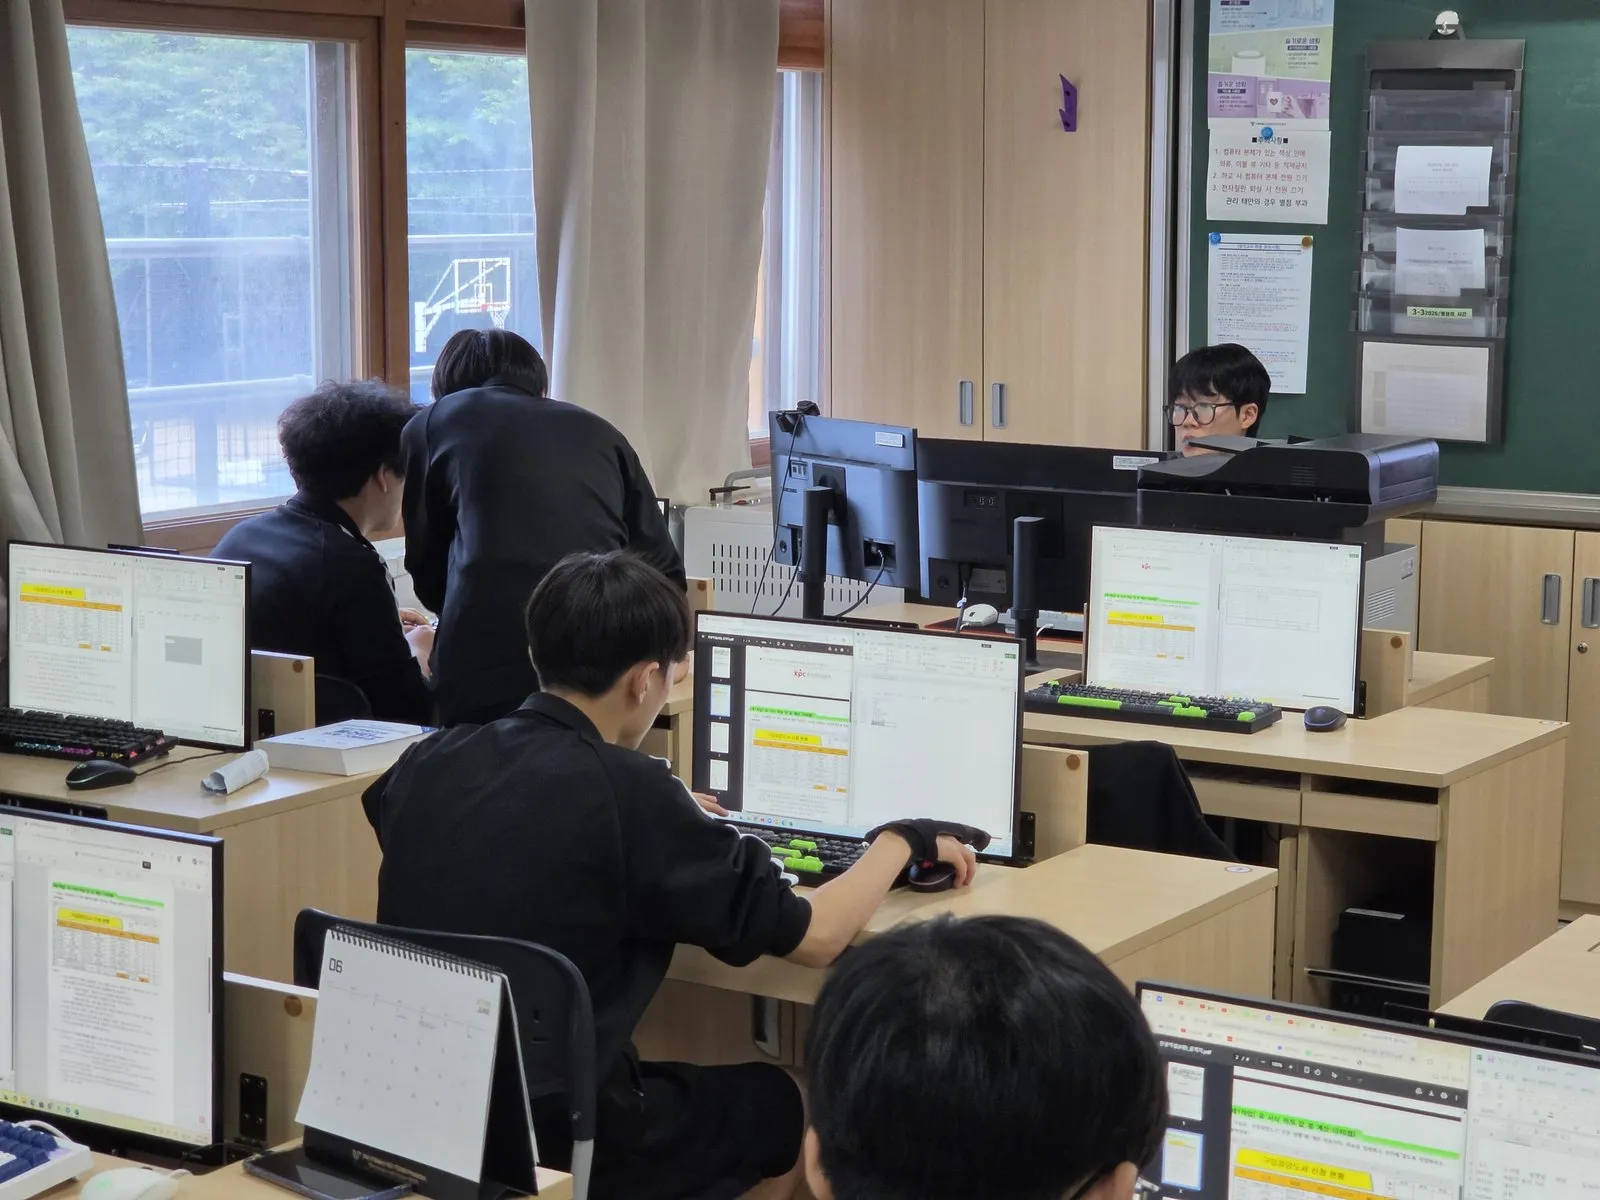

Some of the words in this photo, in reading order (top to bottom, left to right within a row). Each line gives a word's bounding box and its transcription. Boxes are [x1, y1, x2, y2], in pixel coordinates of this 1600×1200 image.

[1224, 148, 1241, 156] 컴퓨터
[1265, 149, 1276, 157] 있는
[1284, 161, 1307, 169] 적재금지
[1281, 174, 1292, 182] 전원
[1222, 184, 1246, 192] 전자칠판
[1250, 185, 1262, 193] 퇴실
[1275, 185, 1287, 193] 전원
[1226, 197, 1238, 205] 관리
[1242, 198, 1260, 206] 태만의
[1264, 198, 1275, 207] 경우
[1280, 199, 1292, 207] 벌점
[1295, 199, 1308, 207] 부과
[328, 957, 343, 974] 06
